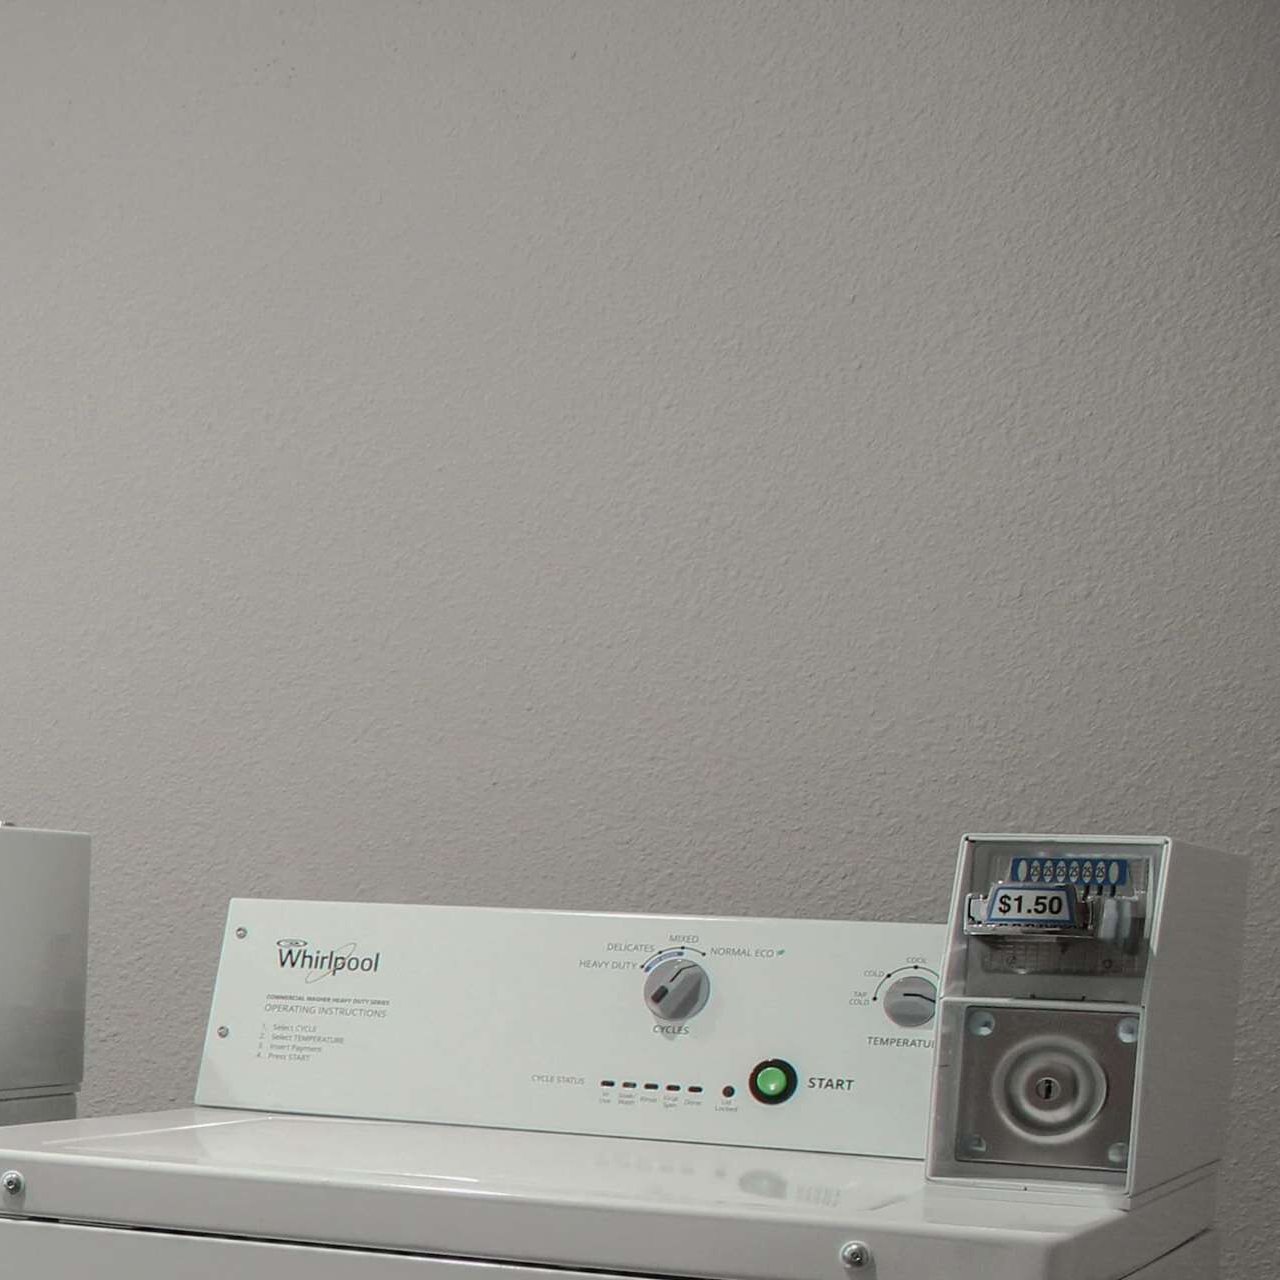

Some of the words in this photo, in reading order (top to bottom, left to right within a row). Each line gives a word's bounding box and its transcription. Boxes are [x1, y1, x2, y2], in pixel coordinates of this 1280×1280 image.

[998, 894, 1063, 915] $1.50
[669, 934, 699, 944] MIXED
[607, 943, 655, 953] DELICATES
[710, 947, 752, 957] NORMAL
[755, 948, 774, 958] ECO
[278, 947, 381, 977] Whirlpool
[579, 960, 610, 969] HEAVY
[611, 961, 637, 970] DUTY
[863, 970, 884, 978] COLD
[264, 1003, 316, 1015] OPERATING
[317, 1005, 388, 1018] INSTRUCTIONS
[652, 1024, 690, 1035] CYCLES
[531, 1074, 555, 1083] CYCLE
[556, 1075, 585, 1085] STATUS
[807, 1076, 855, 1091] START
